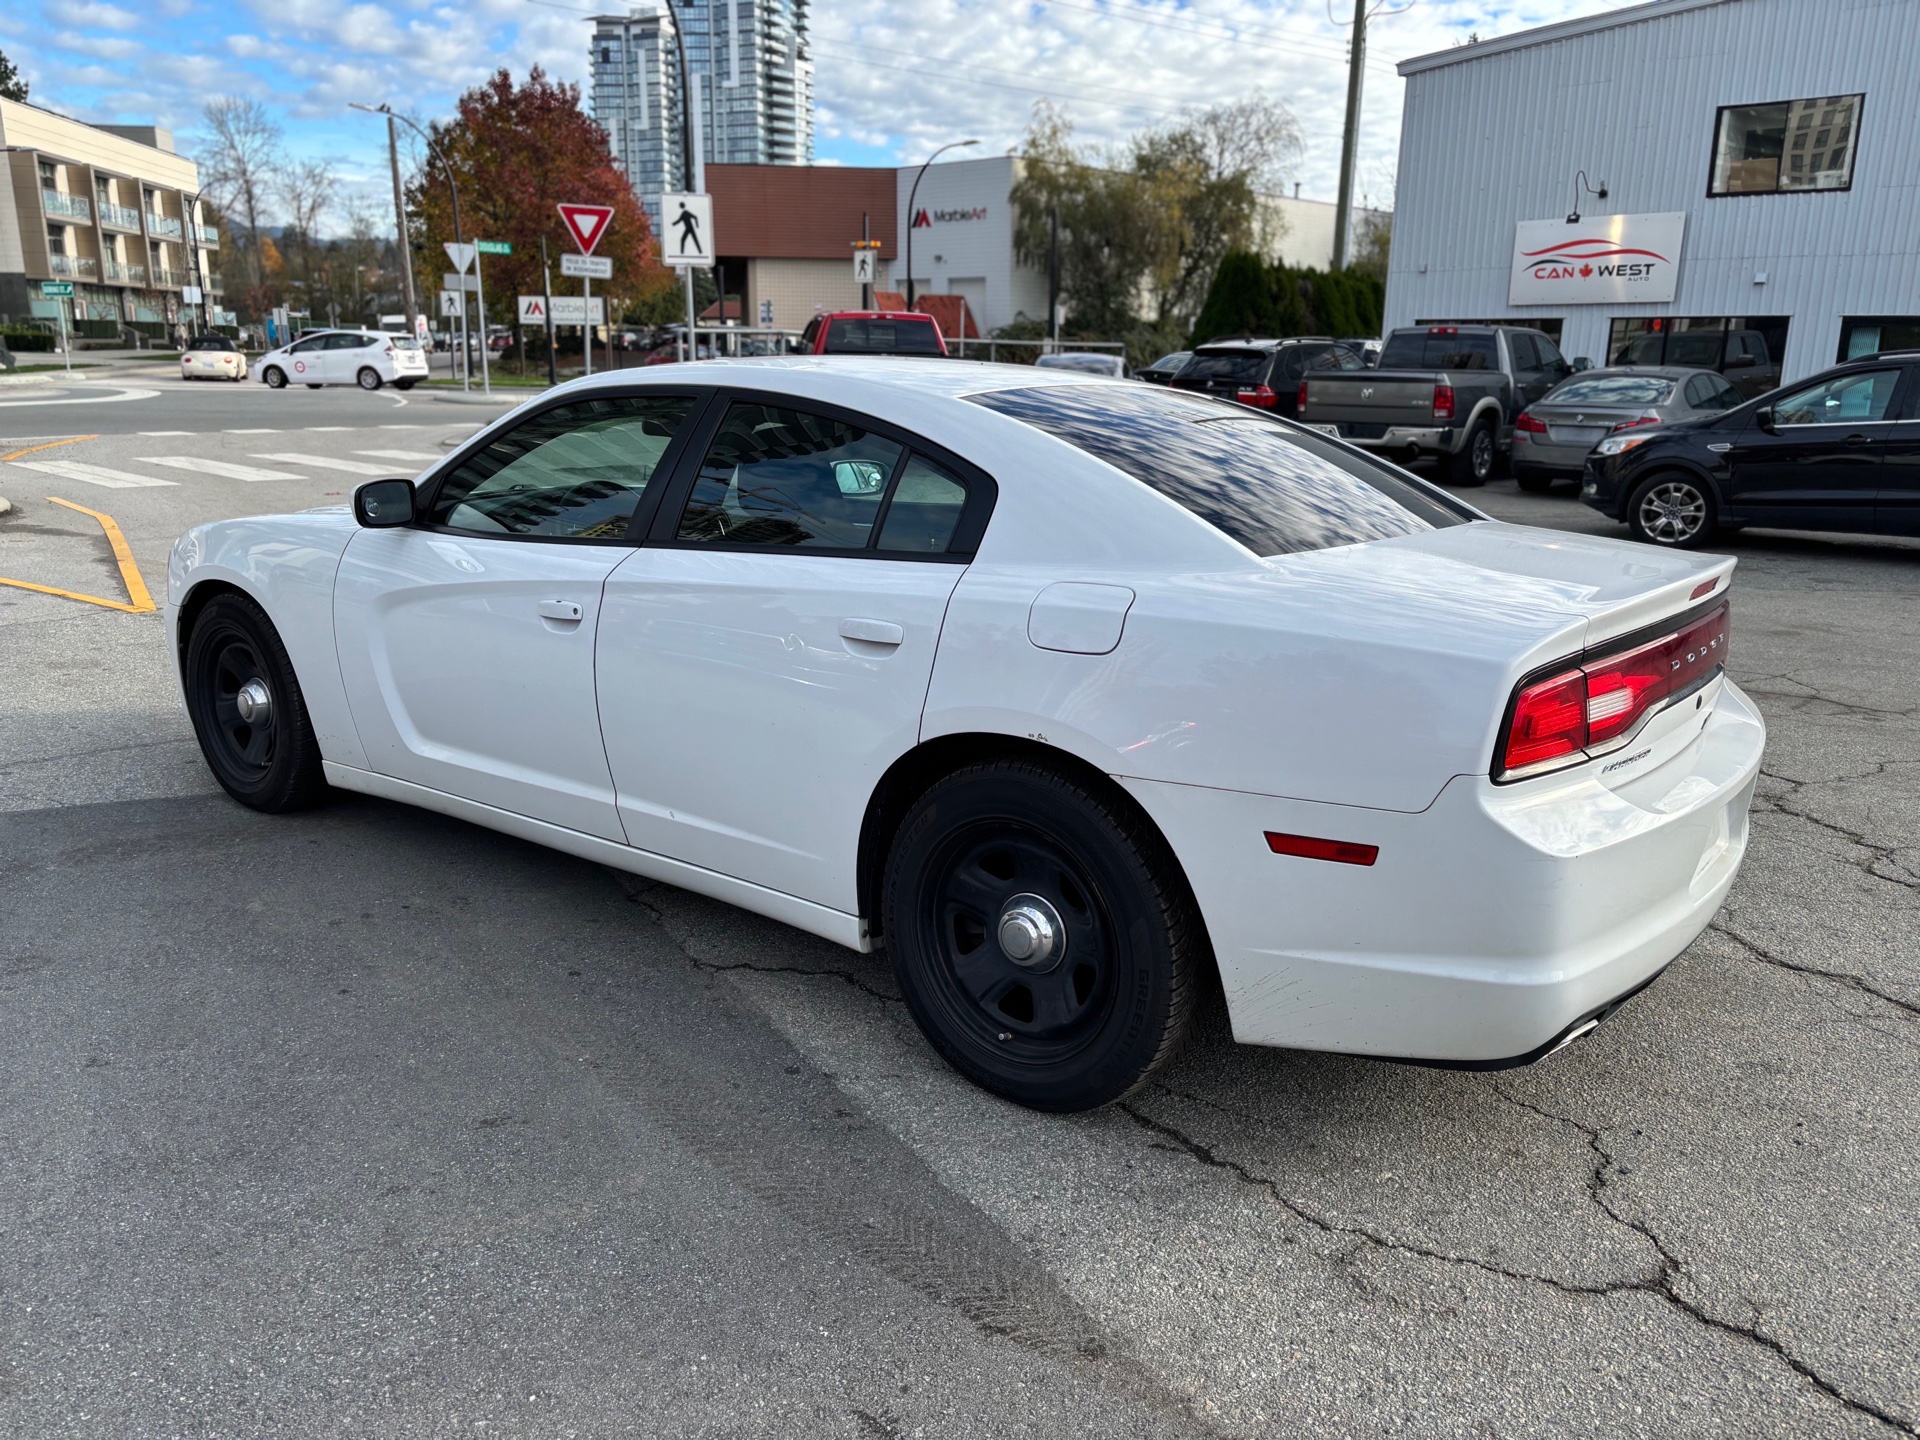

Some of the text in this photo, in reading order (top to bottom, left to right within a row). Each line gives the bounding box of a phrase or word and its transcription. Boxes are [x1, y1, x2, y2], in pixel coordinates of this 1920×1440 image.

[933, 206, 987, 223] MarbleArt
[574, 266, 608, 275] ROUNDABOUT
[1534, 263, 1657, 280] CAN WEST
[549, 302, 599, 314] Marblert
[1671, 633, 1724, 671] DODGE
